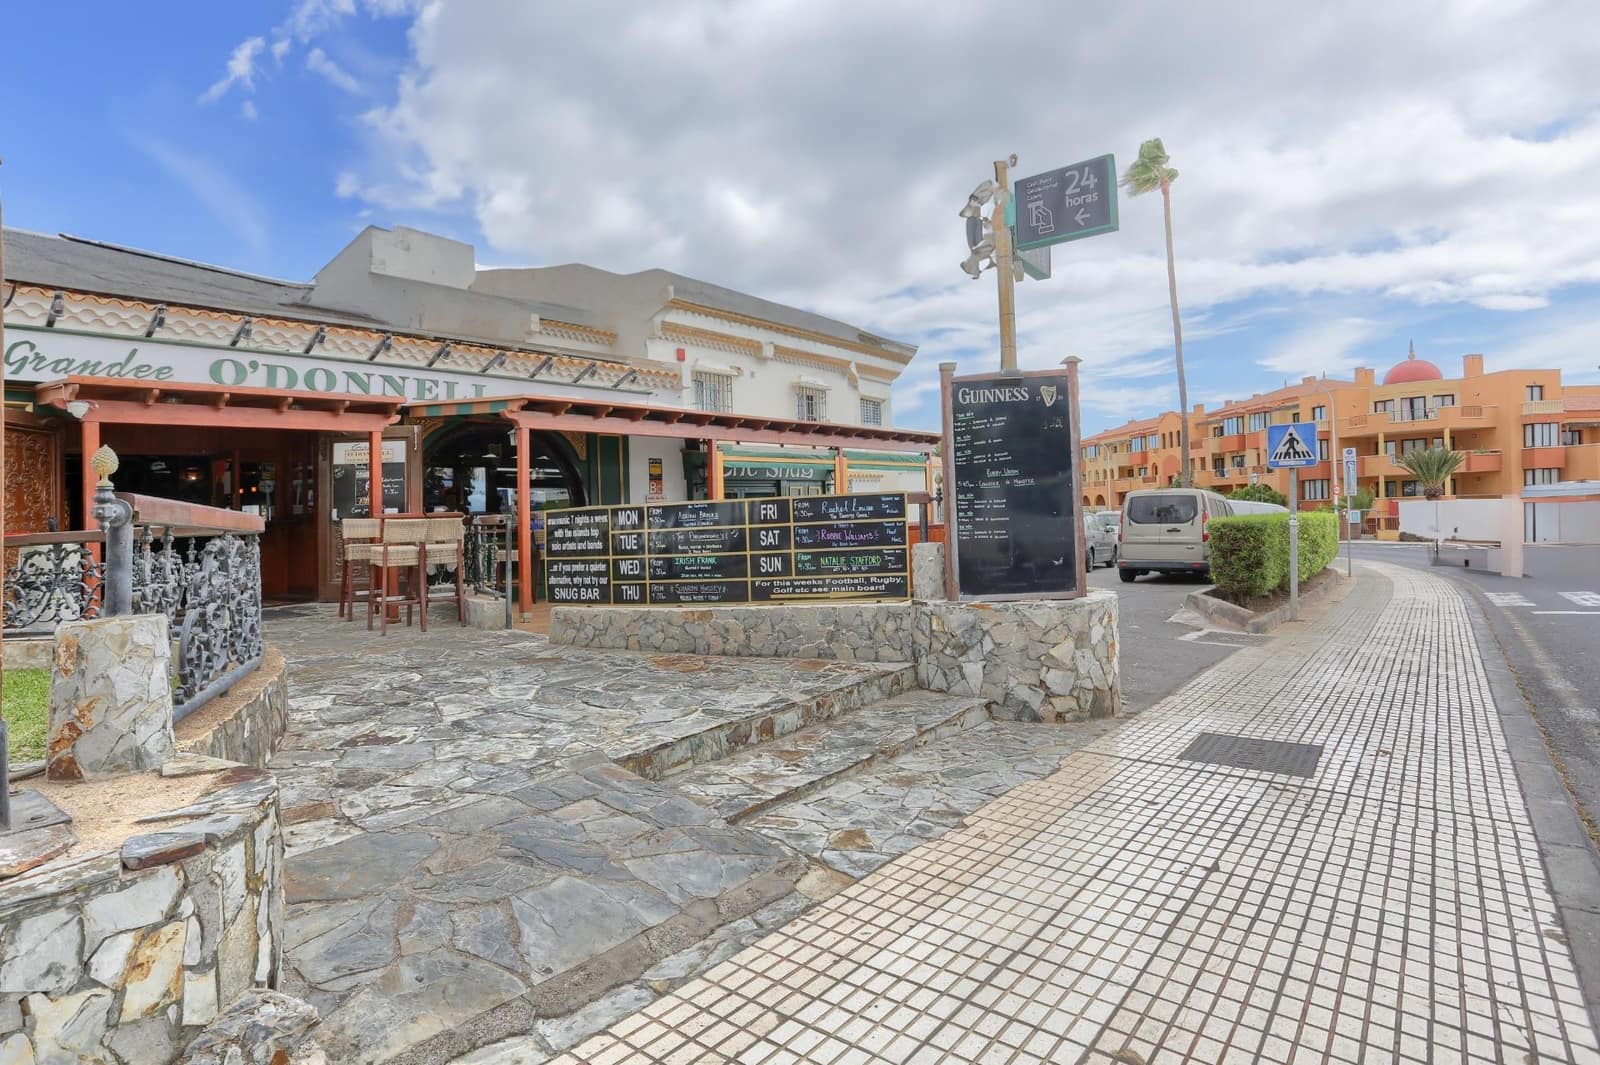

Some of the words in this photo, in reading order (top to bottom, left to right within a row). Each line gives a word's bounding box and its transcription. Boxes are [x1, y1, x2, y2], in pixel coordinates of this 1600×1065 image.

[1065, 166, 1099, 195] 24
[1065, 192, 1099, 208] horas
[4, 340, 174, 381] Grandee
[958, 387, 1029, 404] GUINNESS
[618, 510, 638, 525] MON
[760, 504, 777, 520] FRI
[620, 535, 638, 550] TUE
[760, 530, 780, 546] SAT
[620, 560, 640, 575] WED
[760, 557, 782, 572] SUN
[755, 580, 771, 588] For
[773, 579, 791, 587] this
[812, 585, 829, 593] see
[831, 585, 855, 593] main
[554, 588, 578, 600] SNUG
[580, 588, 600, 600] BAR
[621, 585, 640, 600] THU
